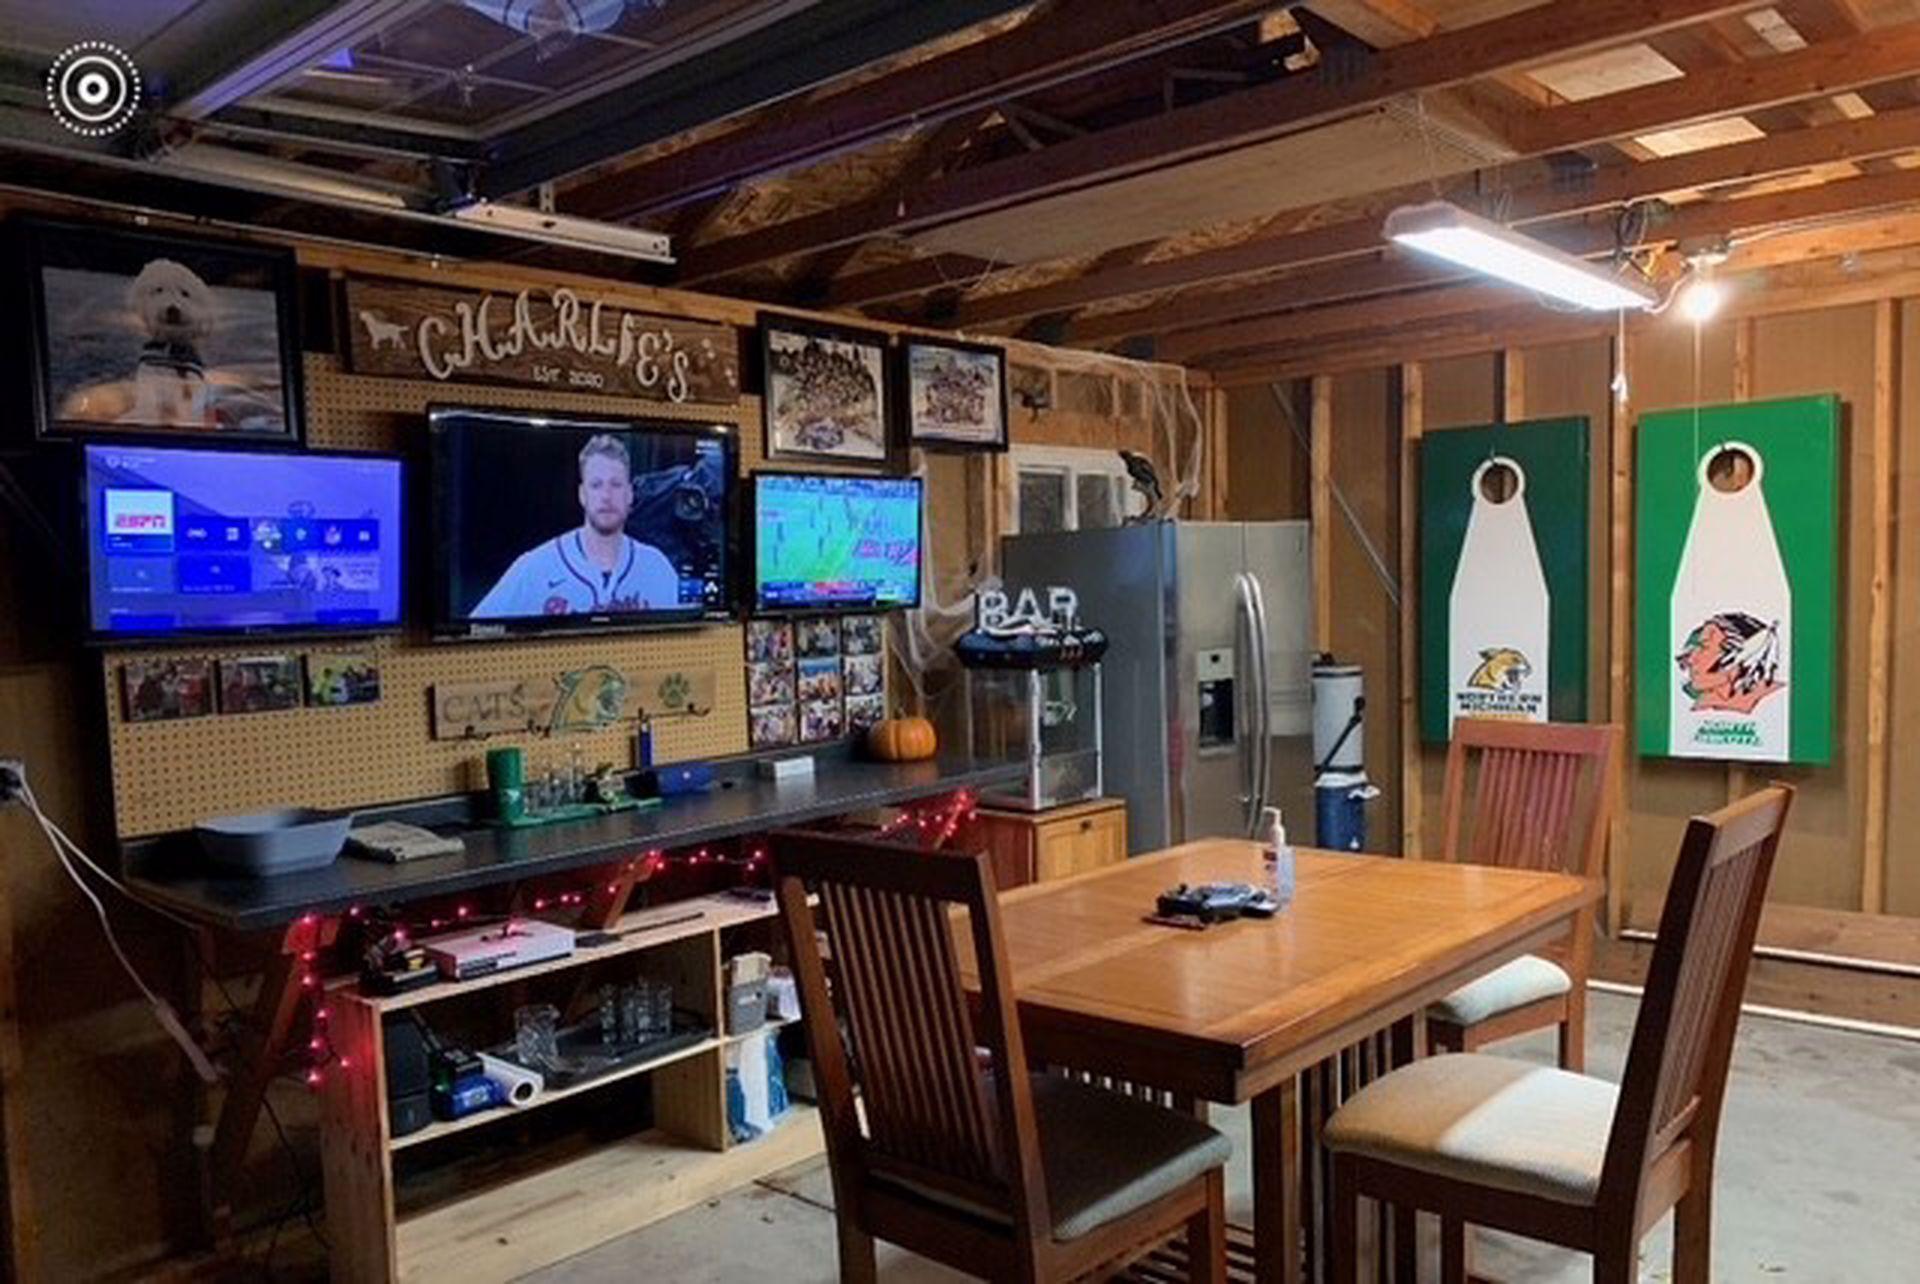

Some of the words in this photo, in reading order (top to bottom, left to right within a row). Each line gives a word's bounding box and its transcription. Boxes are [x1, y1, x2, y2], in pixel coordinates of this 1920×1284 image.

[114, 513, 167, 529] ESPN
[979, 586, 1079, 632] BAR
[442, 683, 527, 724] CATS
[1456, 692, 1542, 703] NORTHERN
[1460, 703, 1538, 713] MICHIGAN
